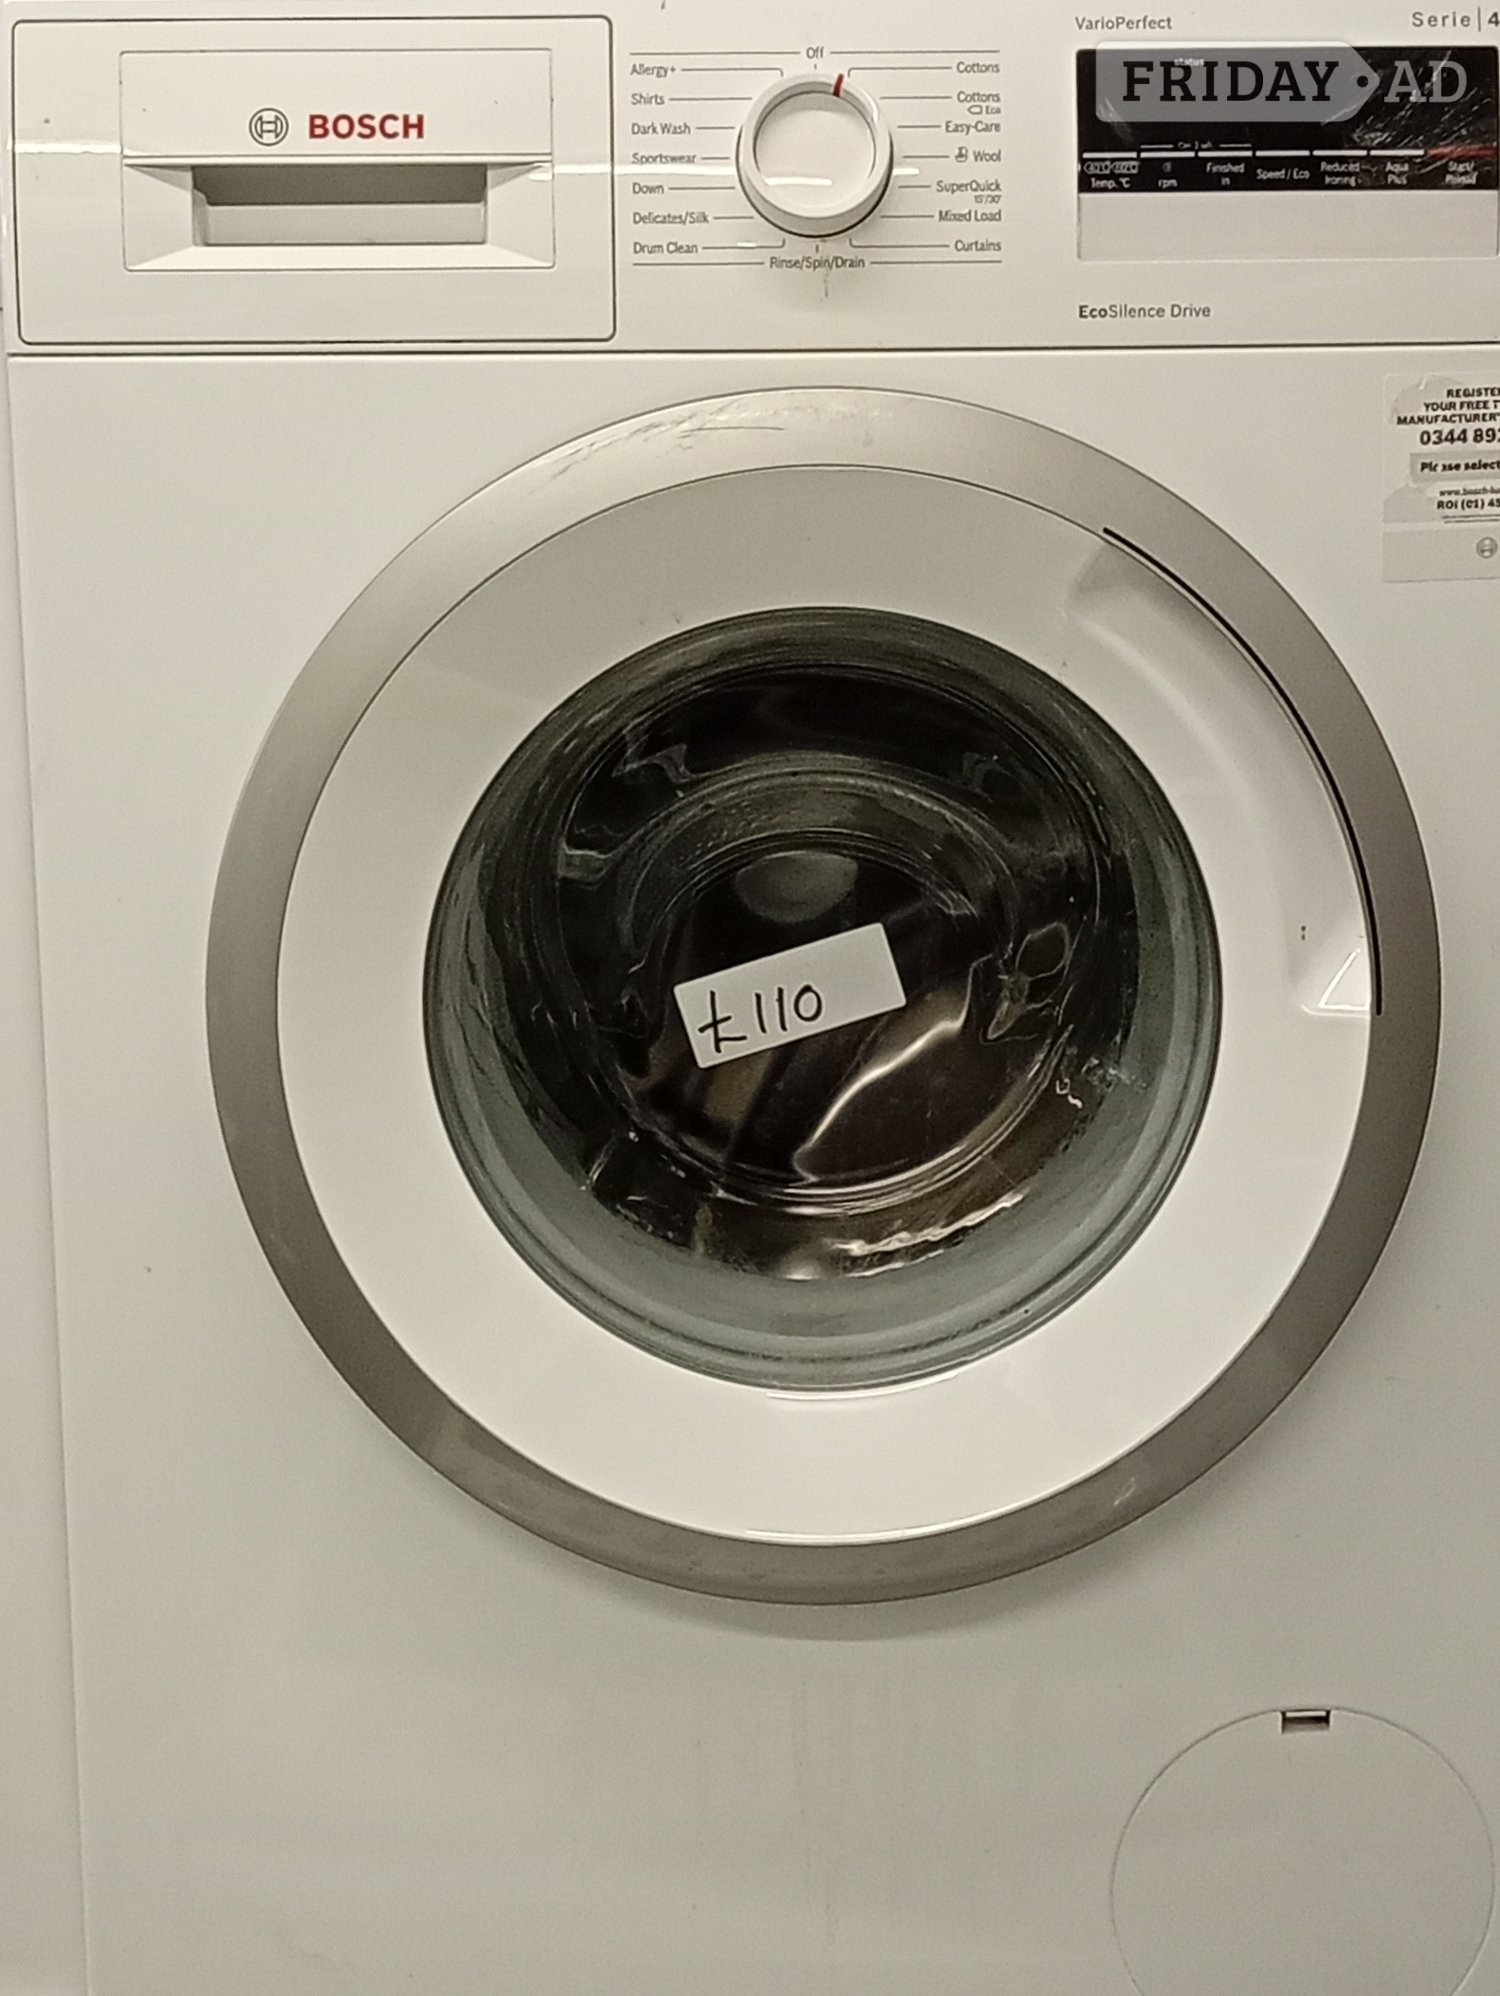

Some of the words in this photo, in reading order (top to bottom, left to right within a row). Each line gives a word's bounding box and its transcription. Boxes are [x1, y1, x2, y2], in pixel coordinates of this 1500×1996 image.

[1074, 15, 1173, 31] VarioPerfect
[1411, 11, 1471, 28] Serie
[805, 46, 824, 60] Off
[630, 63, 677, 79] Allergy+
[956, 61, 1001, 74] Cottons
[631, 92, 666, 106] Shirts
[956, 90, 1002, 103] Cottons
[985, 105, 1002, 115] Eco
[308, 113, 426, 140] BOSCH
[631, 122, 659, 135] Dark
[660, 121, 692, 135] Wash
[944, 120, 1002, 136] Easy-Care
[631, 152, 697, 165] Sportswear
[972, 148, 1002, 163] Wool
[1205, 161, 1246, 174] Finished
[1320, 161, 1361, 173] Reduced
[1256, 168, 1286, 182] Speed
[1292, 168, 1311, 180] Eco
[632, 182, 665, 195] Down
[936, 179, 1002, 195] SuperQuick
[1157, 178, 1178, 189] rpm
[633, 211, 710, 226] Delicates/Silk
[938, 209, 973, 223] Mixed
[974, 208, 1002, 223] Load
[633, 241, 665, 255] Drum
[666, 241, 699, 255] Clean
[954, 239, 1002, 253] Curtains
[769, 256, 866, 272] Rinse/Spin/Drain
[1078, 303, 1167, 320] EcoSilence
[1170, 303, 1212, 319] Drive
[1423, 401, 1457, 412] YOUR
[1459, 400, 1490, 411] FREE
[1420, 428, 1468, 446] 0344
[1436, 499, 1459, 511] ROI
[697, 984, 823, 1053] £110
